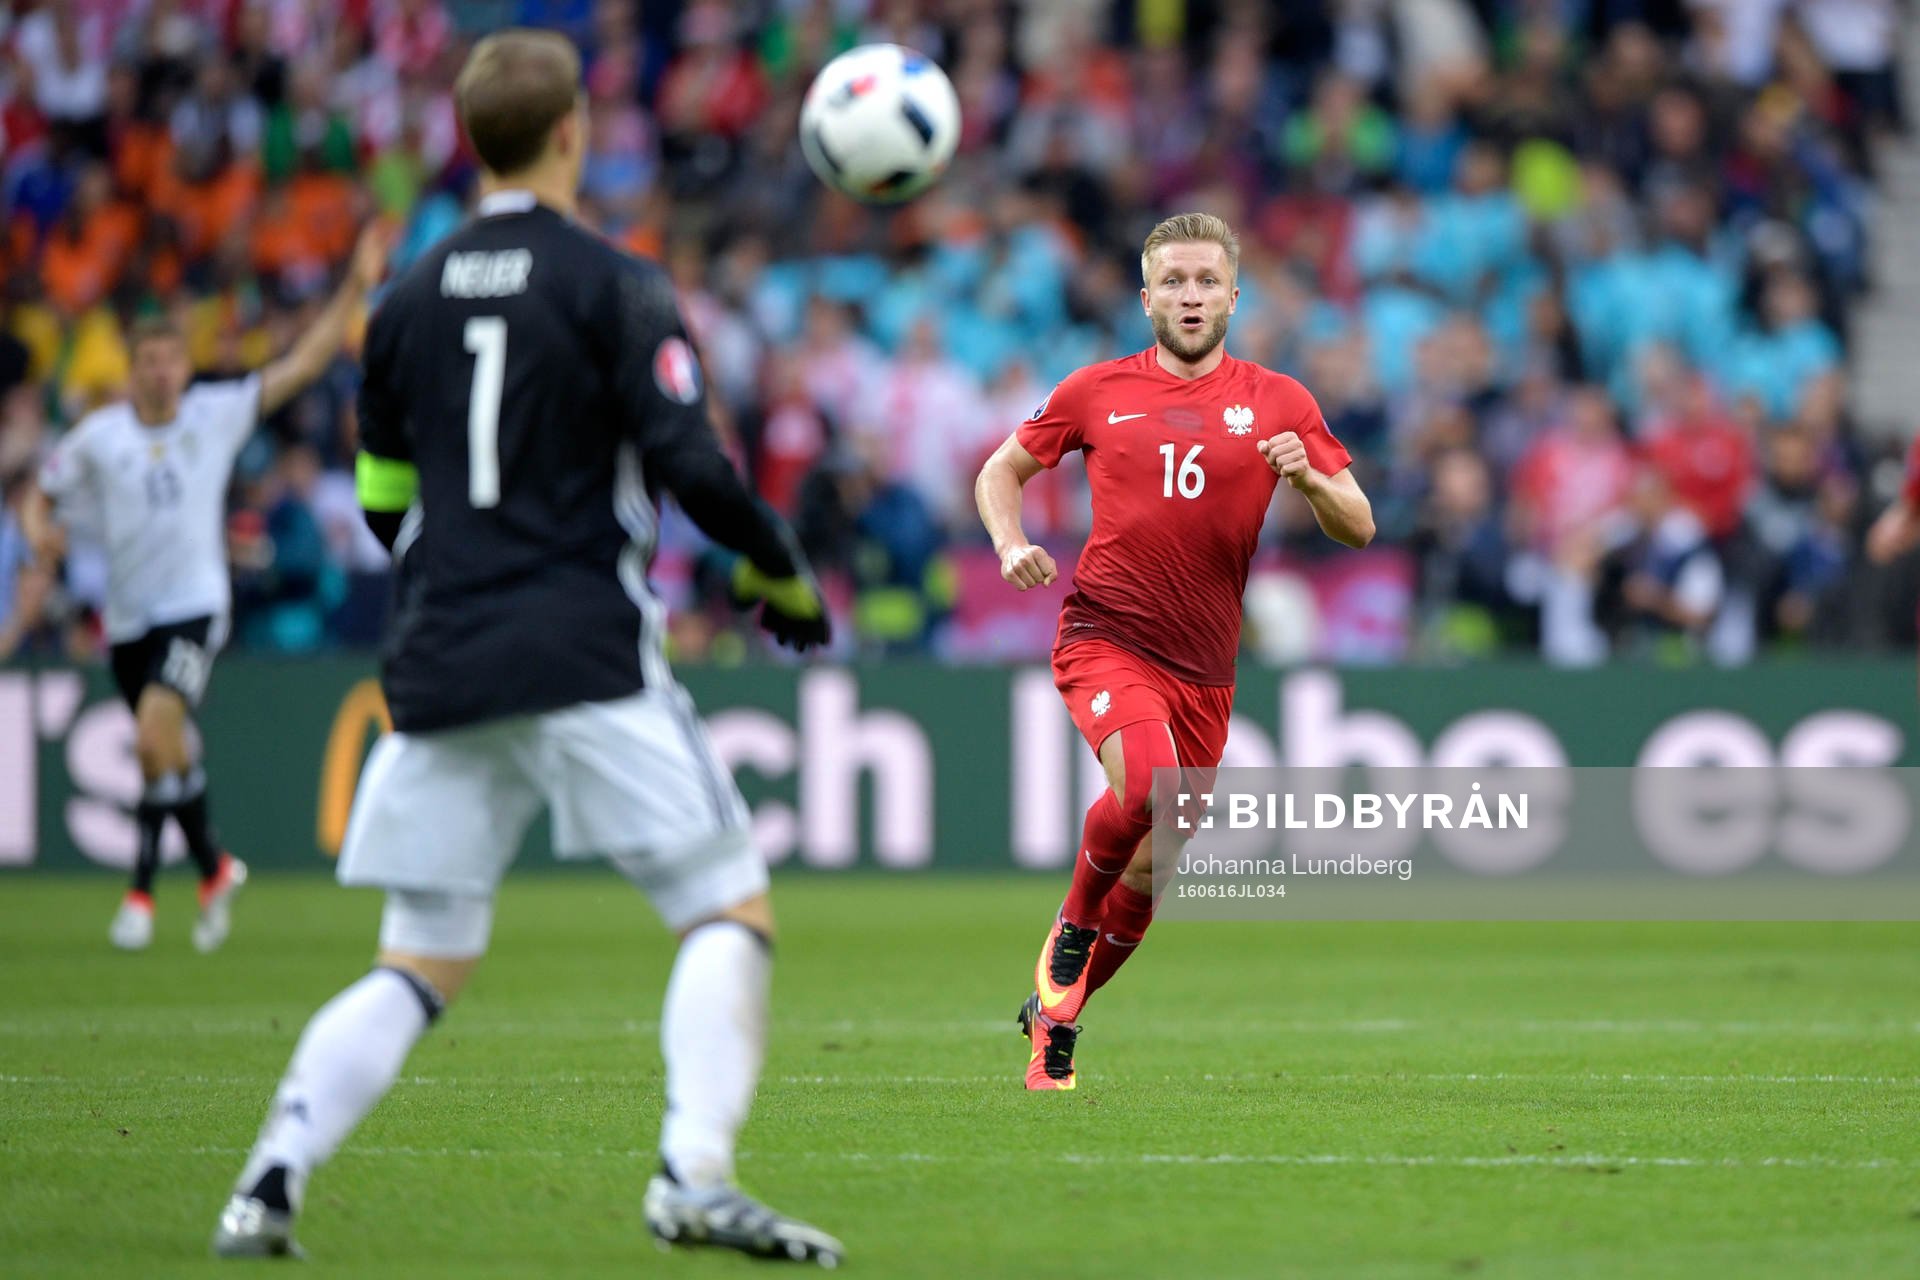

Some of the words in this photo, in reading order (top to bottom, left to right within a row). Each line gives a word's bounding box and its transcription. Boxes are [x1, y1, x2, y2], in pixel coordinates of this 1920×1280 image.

[440, 248, 533, 298] NEUER
[463, 316, 508, 509] 1
[1159, 443, 1206, 500] 16
[1632, 708, 1912, 877] es
